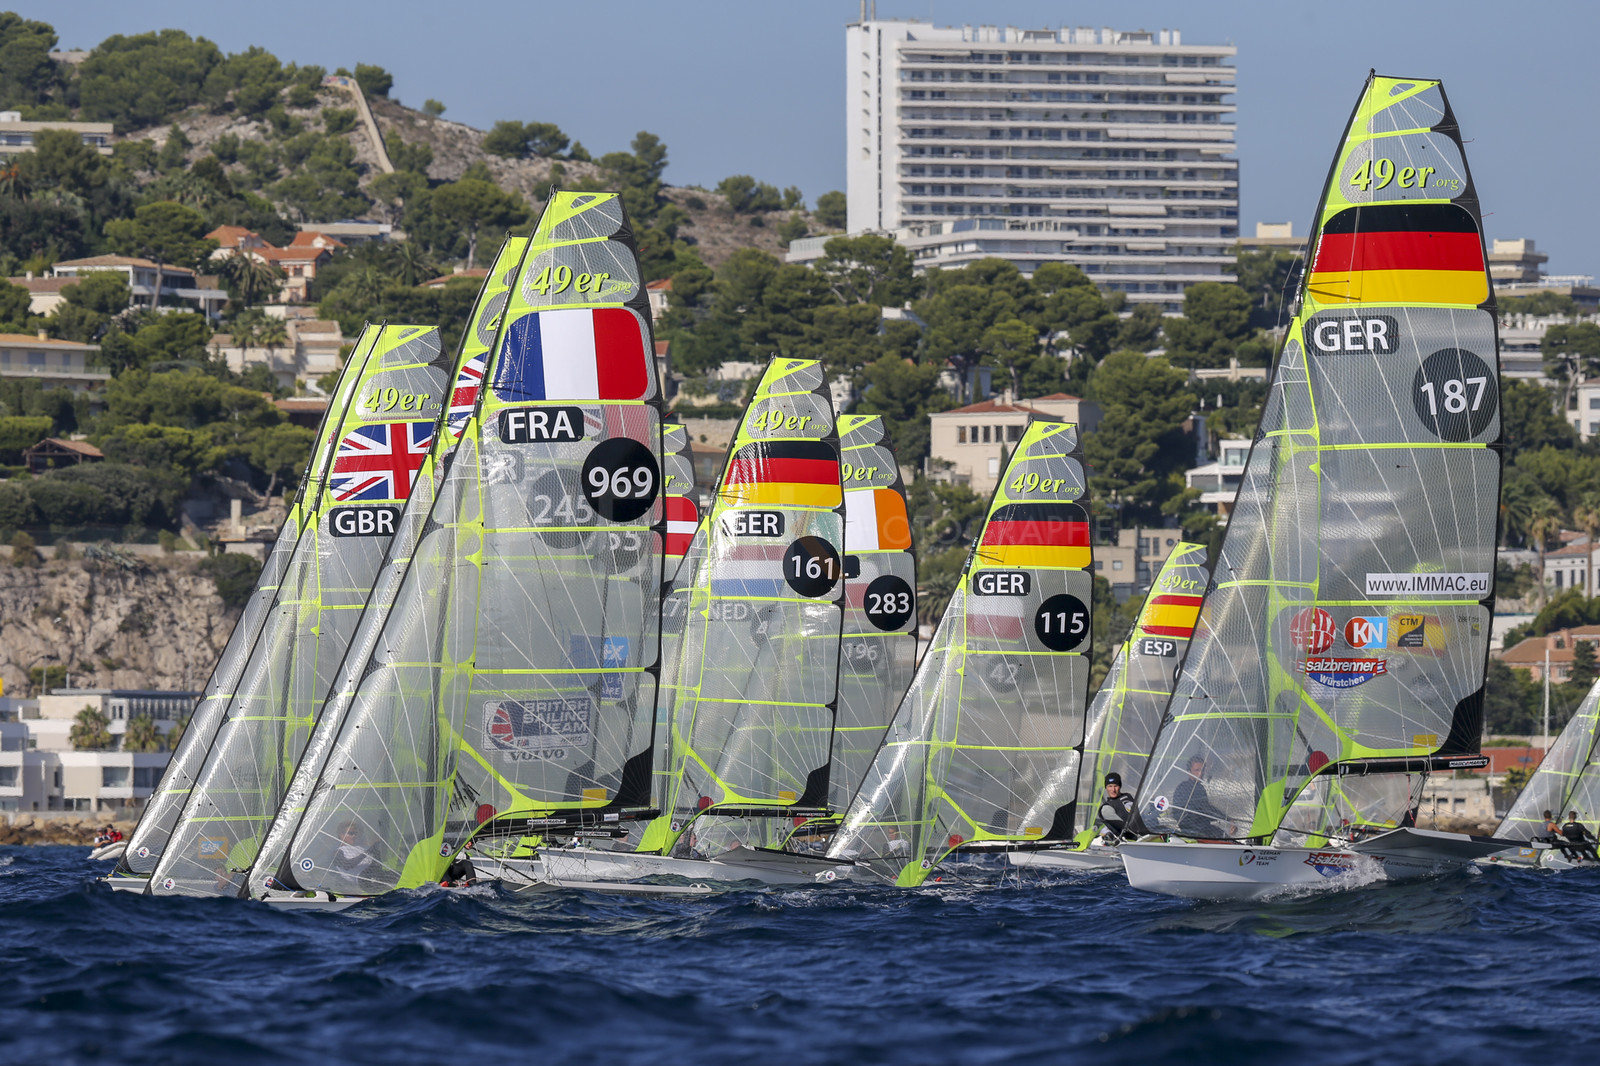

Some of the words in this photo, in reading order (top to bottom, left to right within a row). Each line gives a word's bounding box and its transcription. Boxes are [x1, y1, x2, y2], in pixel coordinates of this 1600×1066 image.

[1313, 319, 1389, 352] GER
[1419, 375, 1487, 416] 187
[508, 410, 575, 441] FRA
[588, 465, 654, 499] 969
[335, 509, 395, 535] GBR
[732, 512, 780, 536] GER
[791, 553, 835, 581] 161
[978, 573, 1025, 595] GER
[1367, 575, 1488, 593] www.IMMAC.eu
[868, 592, 910, 615] 283
[1040, 611, 1085, 634] 115
[1353, 621, 1384, 644] KN
[1399, 617, 1419, 627] CTM
[1143, 640, 1174, 656] ESP
[1306, 657, 1377, 673] salzbrenner
[1319, 673, 1366, 688] Würstchen
[522, 710, 588, 724] SAILING
[523, 699, 589, 714] BRITISH
[541, 722, 587, 735] TEAM
[509, 748, 566, 762] VOLVO
